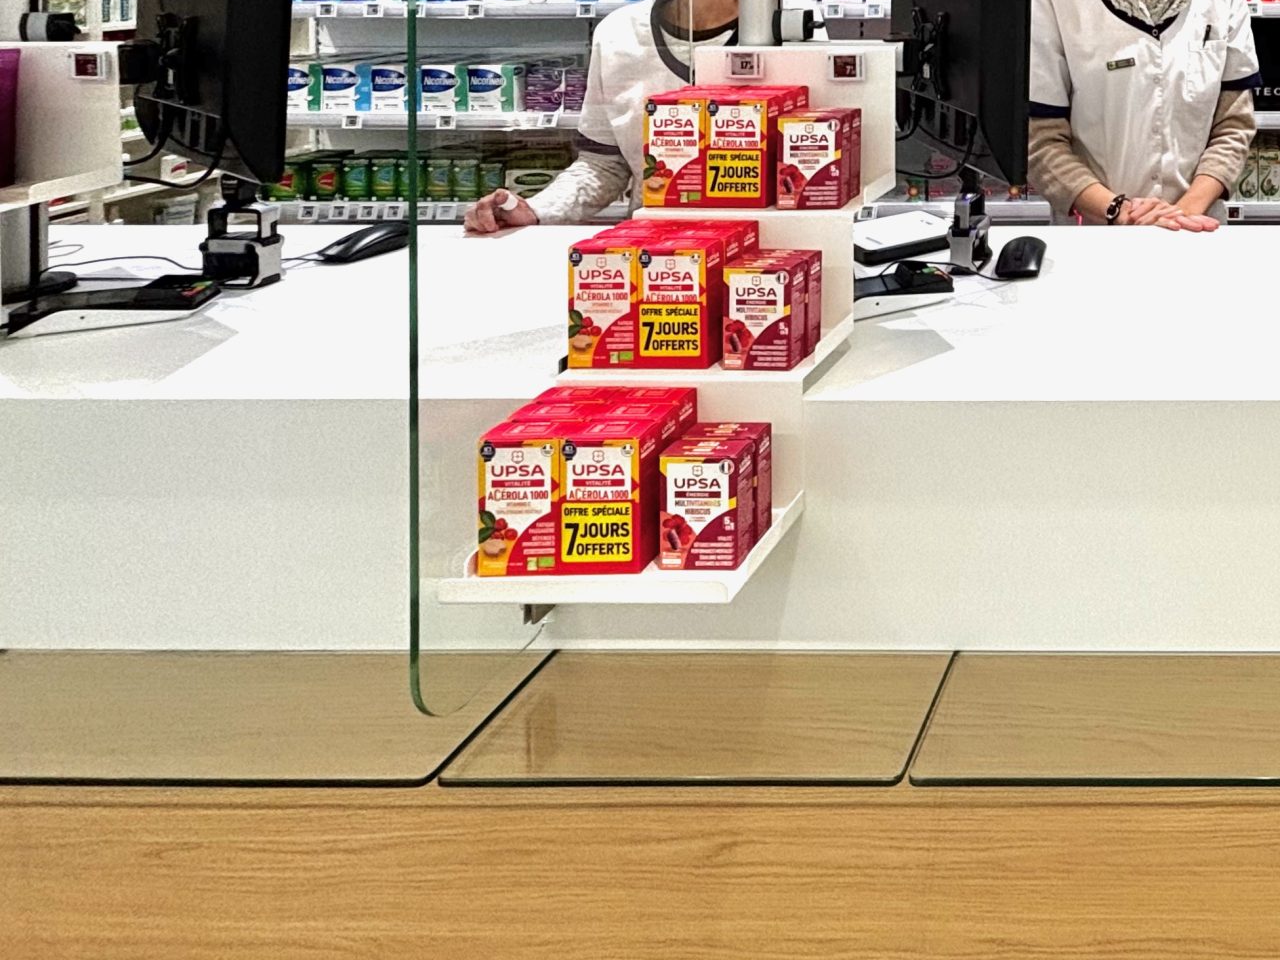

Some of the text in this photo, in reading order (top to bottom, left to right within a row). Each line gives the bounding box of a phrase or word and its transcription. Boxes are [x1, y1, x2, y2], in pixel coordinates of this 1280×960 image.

[653, 119, 694, 129] UPSA
[714, 119, 756, 129] UPSA
[789, 134, 829, 144] UPSA
[708, 152, 760, 162] OFFRE SPÉCIALE
[708, 166, 759, 192] 7 JOURS
[717, 182, 760, 192] OFFERTS
[578, 269, 625, 280] UPSA
[648, 271, 694, 282] UPSA
[735, 287, 777, 298] UPSA
[641, 306, 699, 316] OFFRE SPÉCIALE
[641, 321, 698, 351] 7 JOURS
[652, 339, 699, 351] OFFERTS
[491, 465, 545, 477] UPSA
[572, 464, 625, 476] UPSA
[674, 478, 721, 489] UPSA
[530, 490, 549, 500] 1000
[610, 489, 629, 500] 1000
[563, 505, 630, 517] OFFRE SPÉCIALE
[564, 523, 580, 556] 7
[580, 522, 630, 538] JOURS
[576, 542, 630, 556] OFFERTS
